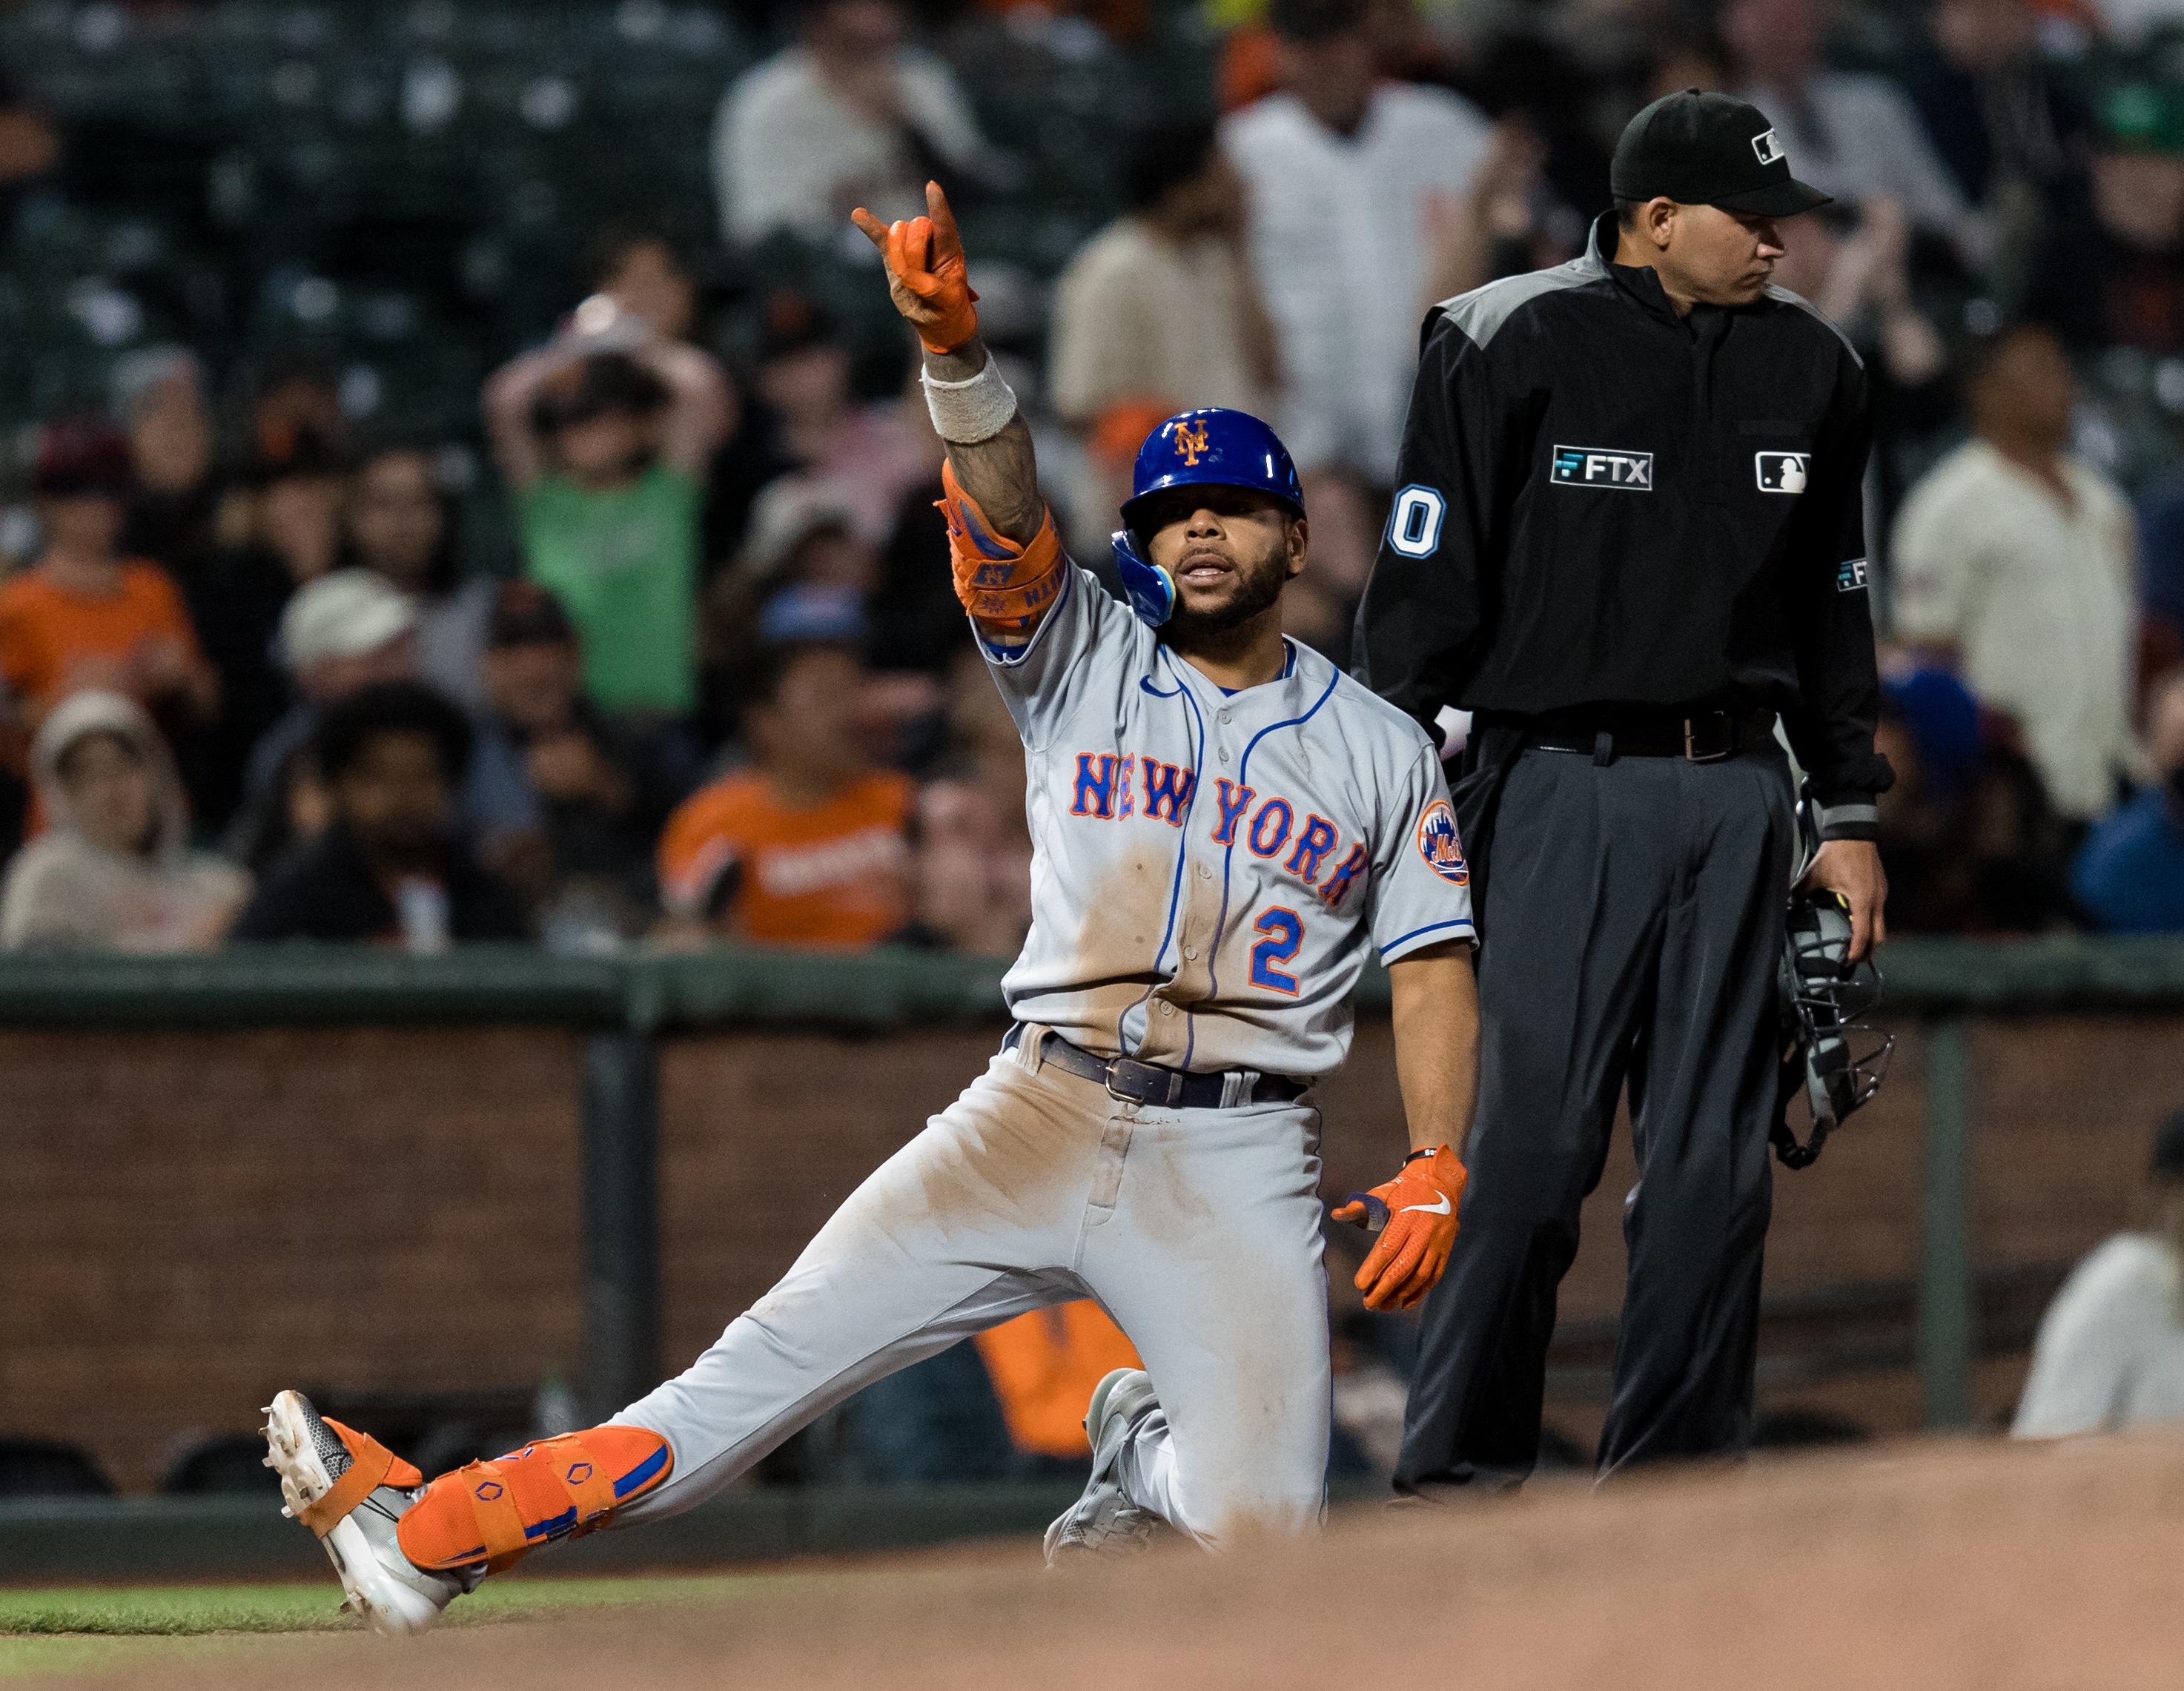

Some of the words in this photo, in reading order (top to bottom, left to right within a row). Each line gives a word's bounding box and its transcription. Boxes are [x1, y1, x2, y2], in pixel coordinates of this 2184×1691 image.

[1586, 454, 1649, 484] FTX
[1069, 752, 1197, 827] NEW
[1211, 776, 1369, 907] YORK
[1248, 904, 1305, 997] 2
